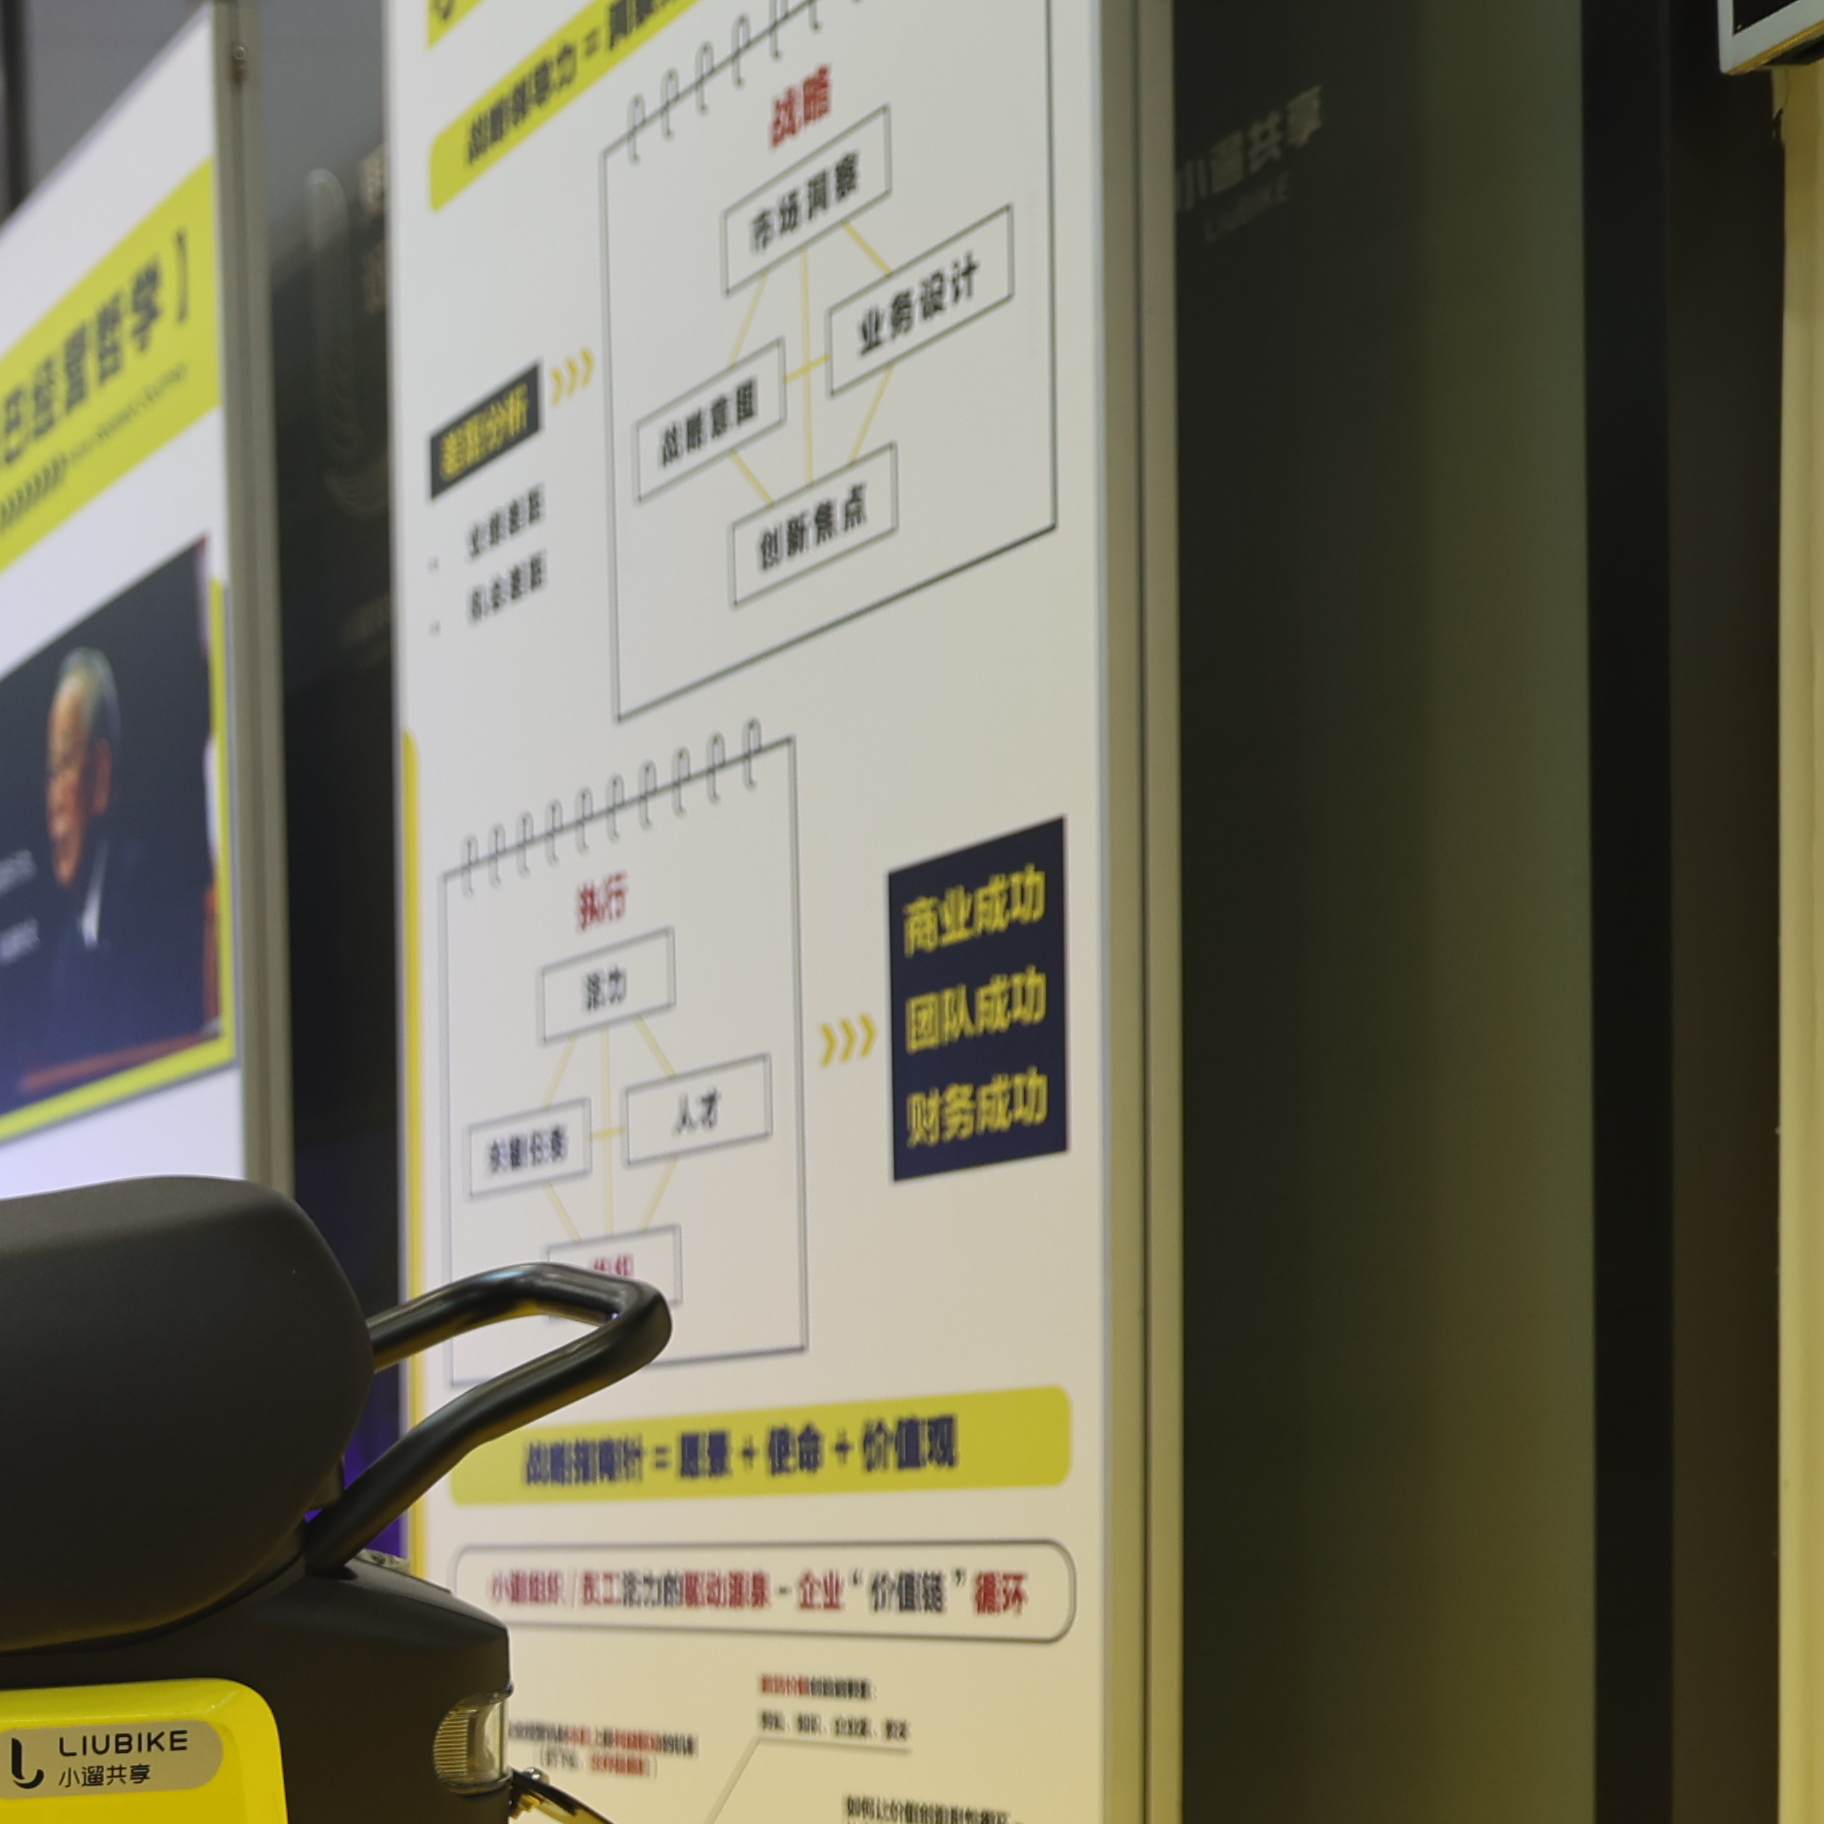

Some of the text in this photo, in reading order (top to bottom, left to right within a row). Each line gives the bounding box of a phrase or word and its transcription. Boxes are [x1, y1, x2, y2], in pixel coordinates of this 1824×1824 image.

[770, 64, 832, 148] 战略
[750, 148, 859, 252] 市场洞察
[858, 253, 980, 358] 业务设计
[660, 374, 759, 468] 战略意图
[757, 482, 868, 572] 创新焦点
[903, 863, 1045, 956] 商业成功
[905, 965, 1046, 1053] 团队成功
[672, 1088, 719, 1136] 人才
[905, 1066, 1048, 1150] 财务成功
[767, 1423, 824, 1475] 使命
[861, 1413, 959, 1472] 价值观
[58, 1729, 189, 1757] LIUBIKE
[58, 1763, 151, 1788] 小遛共享
